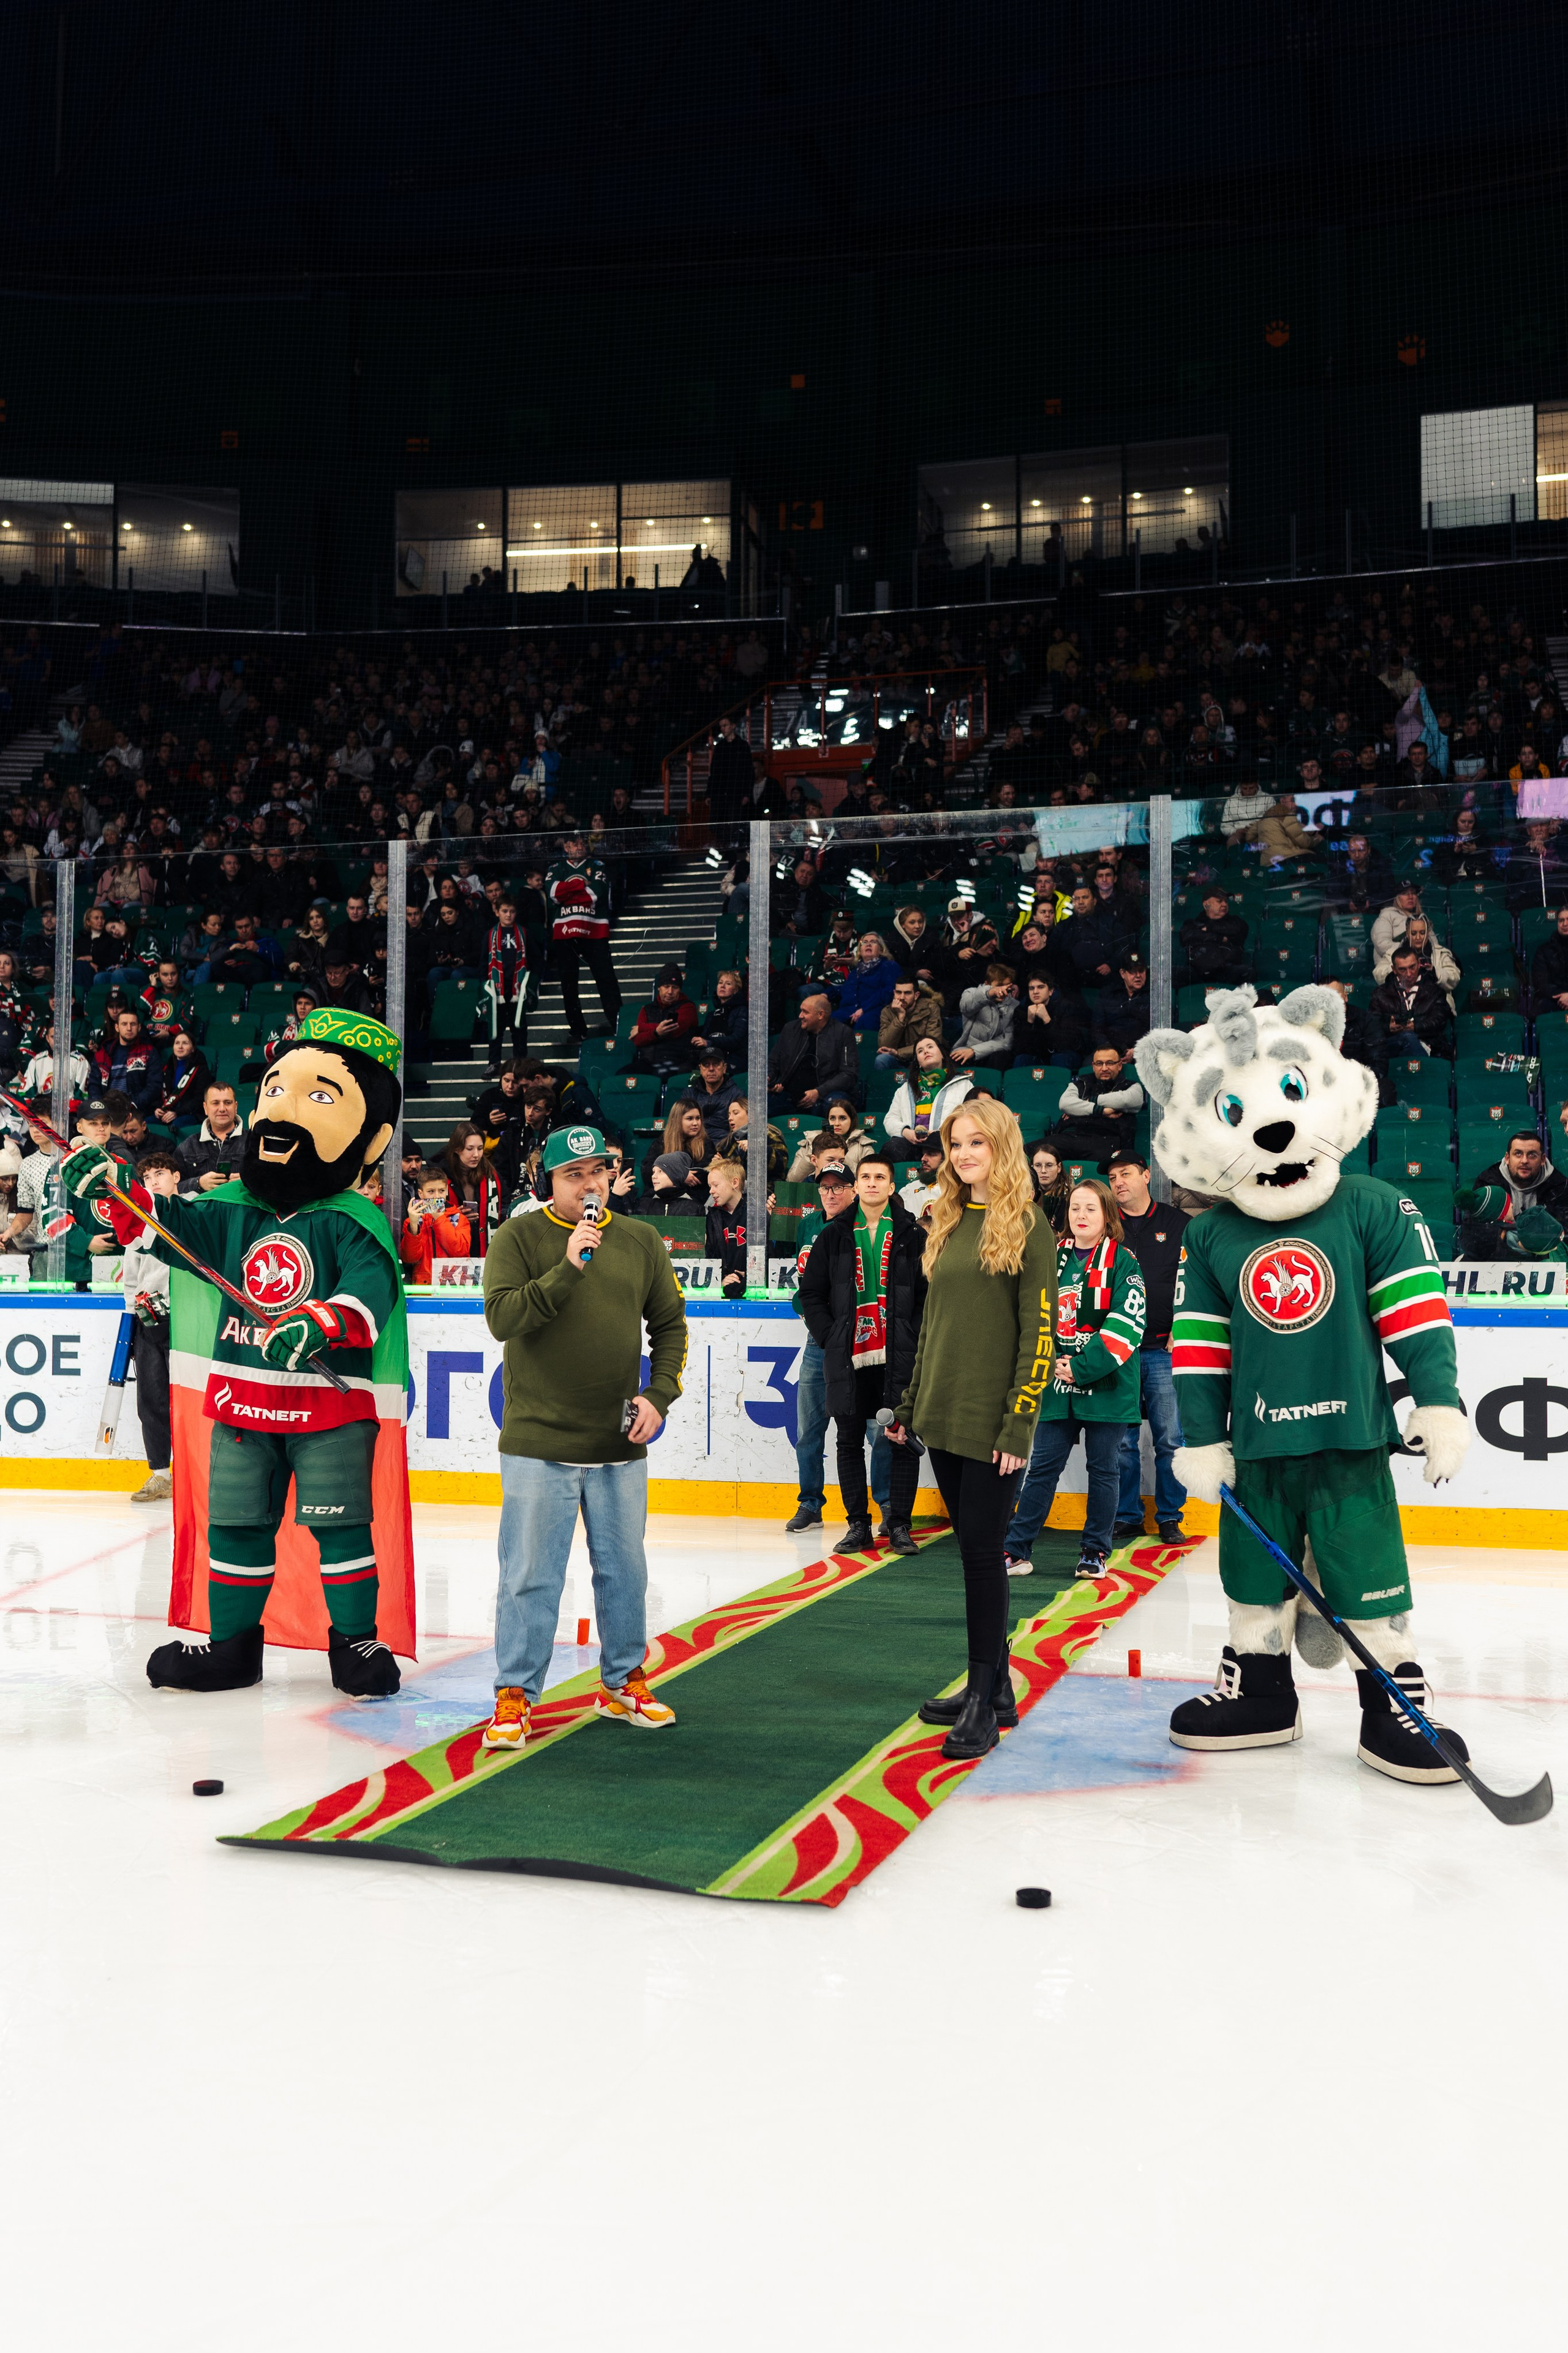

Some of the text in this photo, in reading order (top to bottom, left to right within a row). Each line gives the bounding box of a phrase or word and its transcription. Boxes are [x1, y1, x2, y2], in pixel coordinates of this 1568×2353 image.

[1174, 1268, 1186, 1306] 6
[1441, 1271, 1556, 1298] HL.RU
[1123, 1288, 1145, 1326] 82
[0, 1334, 81, 1376] ОЕ
[231, 1402, 312, 1422] TATNEFT
[1268, 1400, 1348, 1422] TATNEFT
[301, 1505, 345, 1514] CCM
[1360, 1584, 1405, 1602] BAUER
